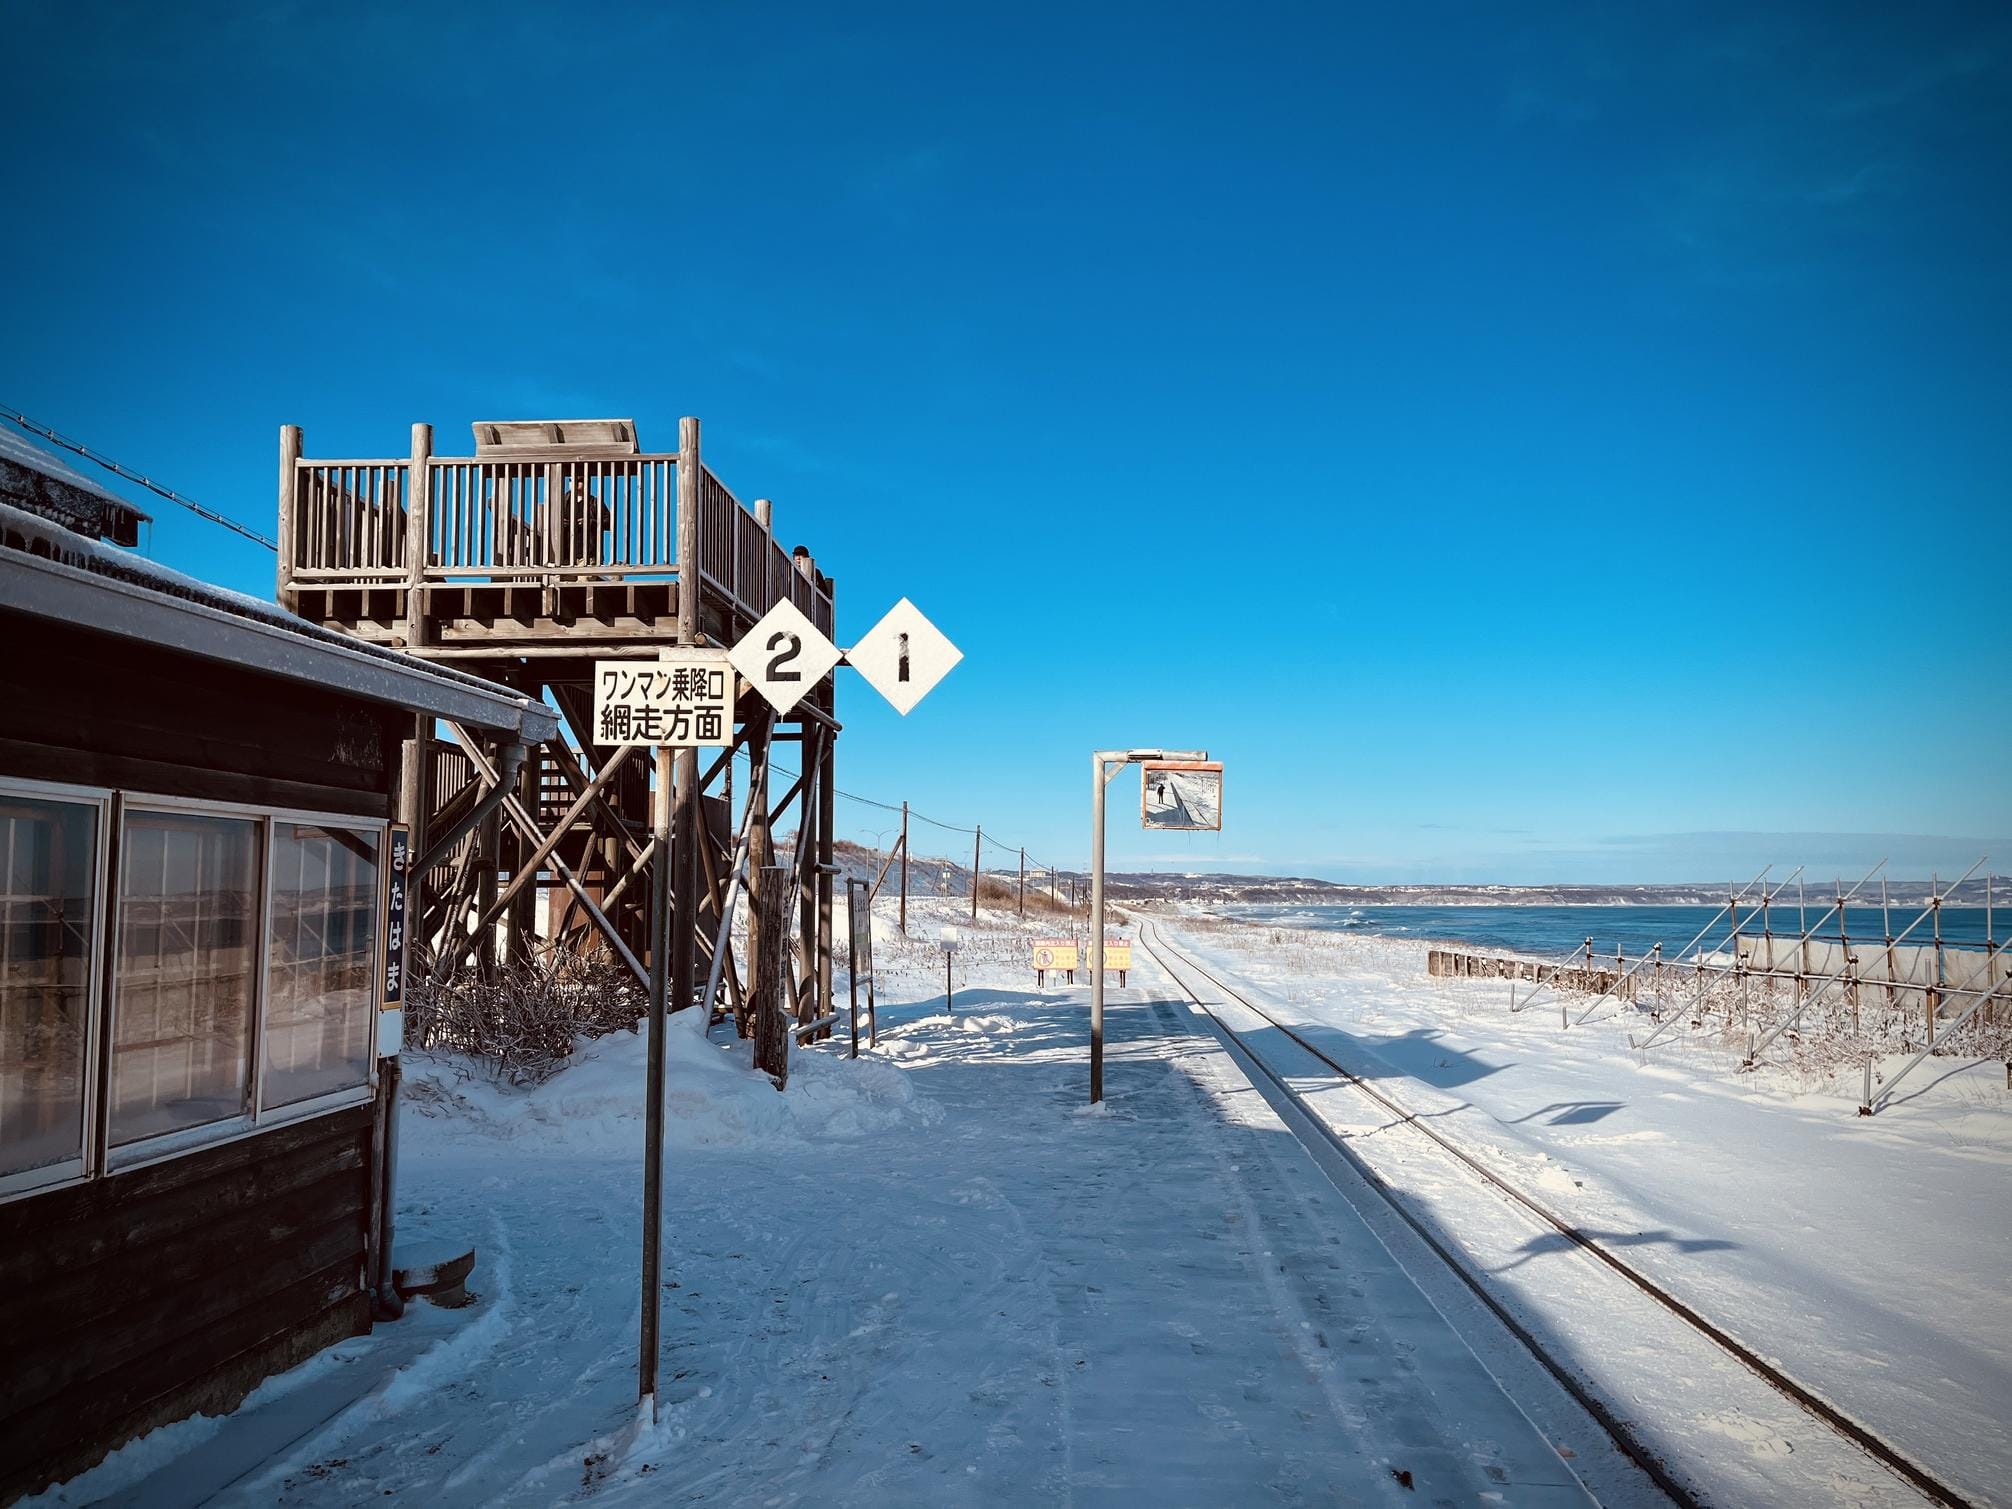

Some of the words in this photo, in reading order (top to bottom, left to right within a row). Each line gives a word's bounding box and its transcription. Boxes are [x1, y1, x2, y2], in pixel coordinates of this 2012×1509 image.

[765, 631, 801, 682] 2
[895, 632, 911, 682] 1
[602, 666, 725, 702] ワンマン乗降口
[600, 703, 725, 741] 網走方面
[387, 841, 405, 992] きたはま
